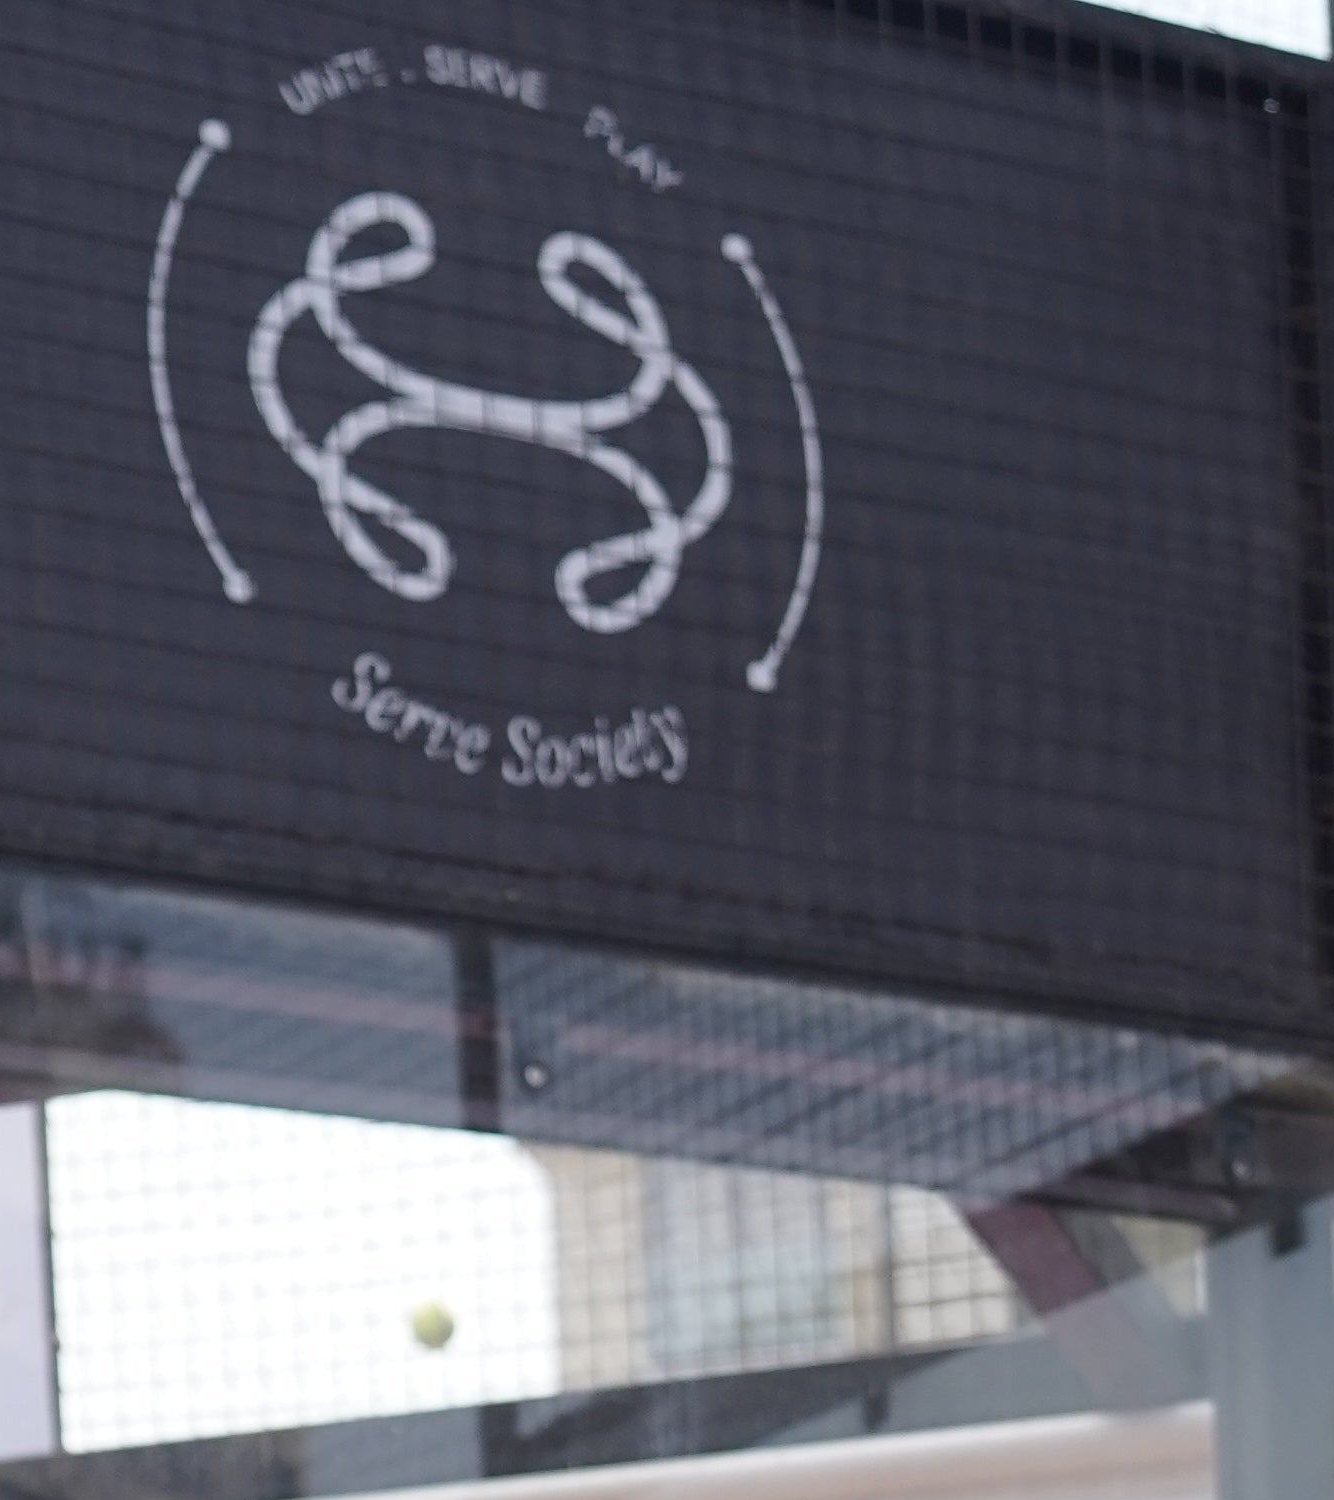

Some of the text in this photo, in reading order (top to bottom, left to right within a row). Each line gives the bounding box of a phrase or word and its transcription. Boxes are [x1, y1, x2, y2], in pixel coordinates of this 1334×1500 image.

[423, 44, 547, 111] SERVE
[332, 652, 690, 788] Serve Society
